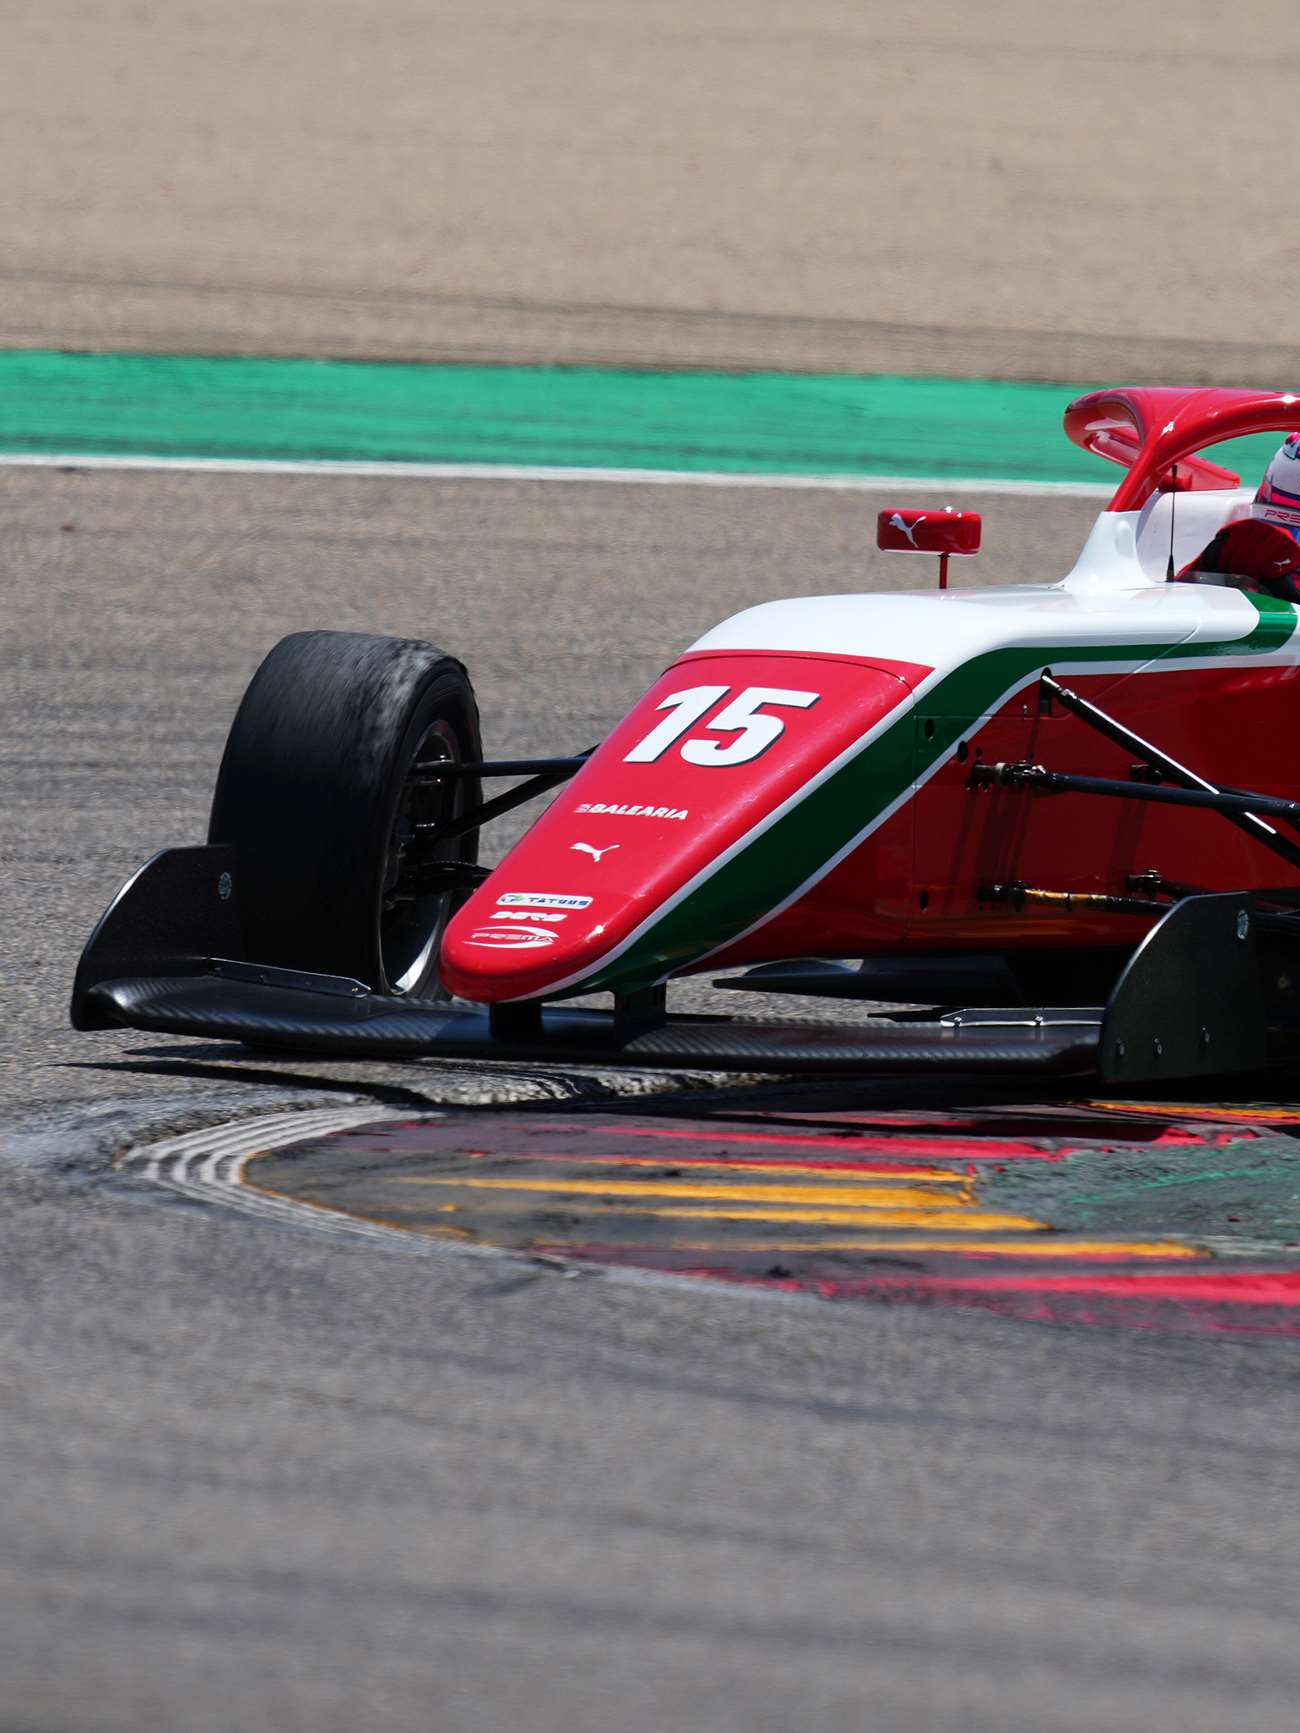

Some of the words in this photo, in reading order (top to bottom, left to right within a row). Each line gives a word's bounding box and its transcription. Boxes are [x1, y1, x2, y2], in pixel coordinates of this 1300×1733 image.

[622, 685, 821, 768] 15
[528, 896, 591, 907] TATUUS
[471, 931, 555, 944] PREMA
